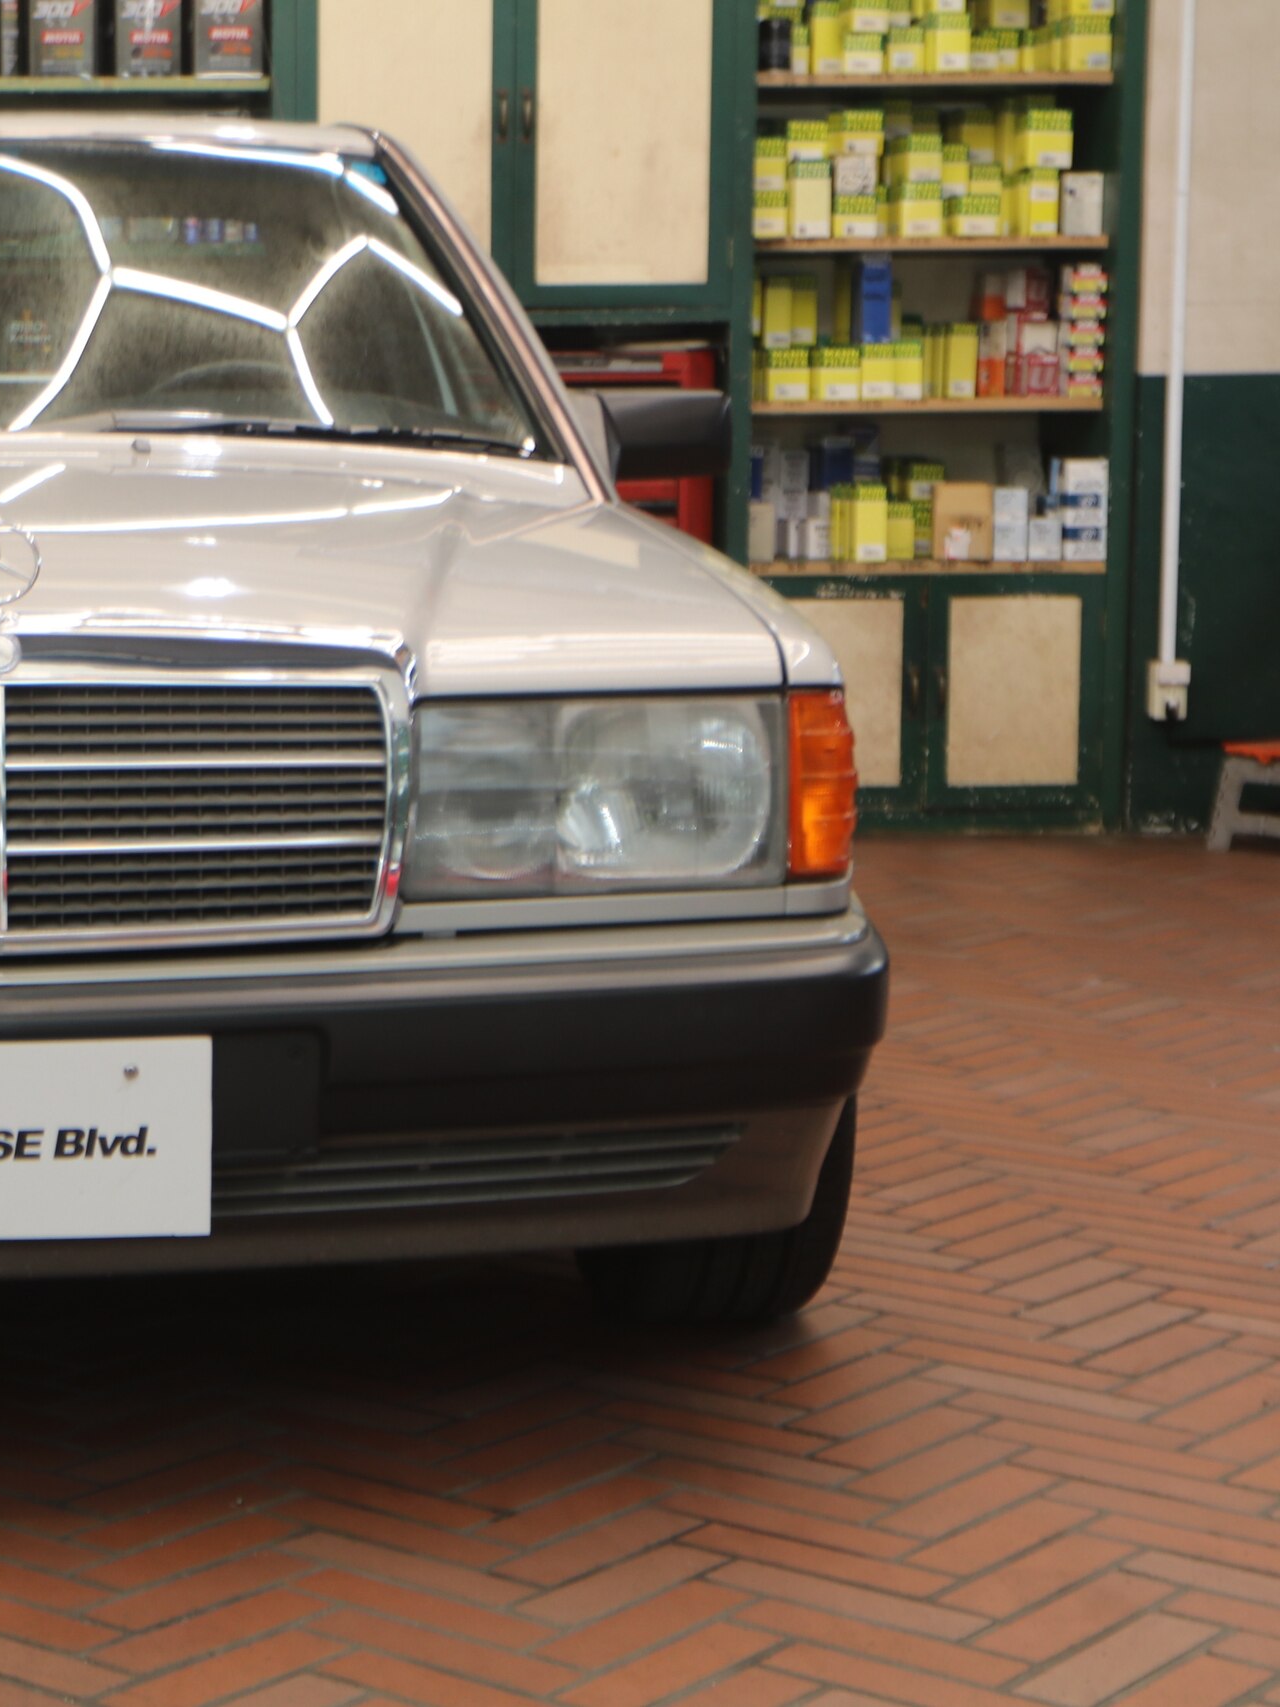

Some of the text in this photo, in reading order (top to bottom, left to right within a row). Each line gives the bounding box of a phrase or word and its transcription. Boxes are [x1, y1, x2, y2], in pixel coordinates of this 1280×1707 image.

[43, 32, 82, 45] MOTUL
[210, 27, 250, 41] MOTUL
[53, 1126, 157, 1160] Blvd.
